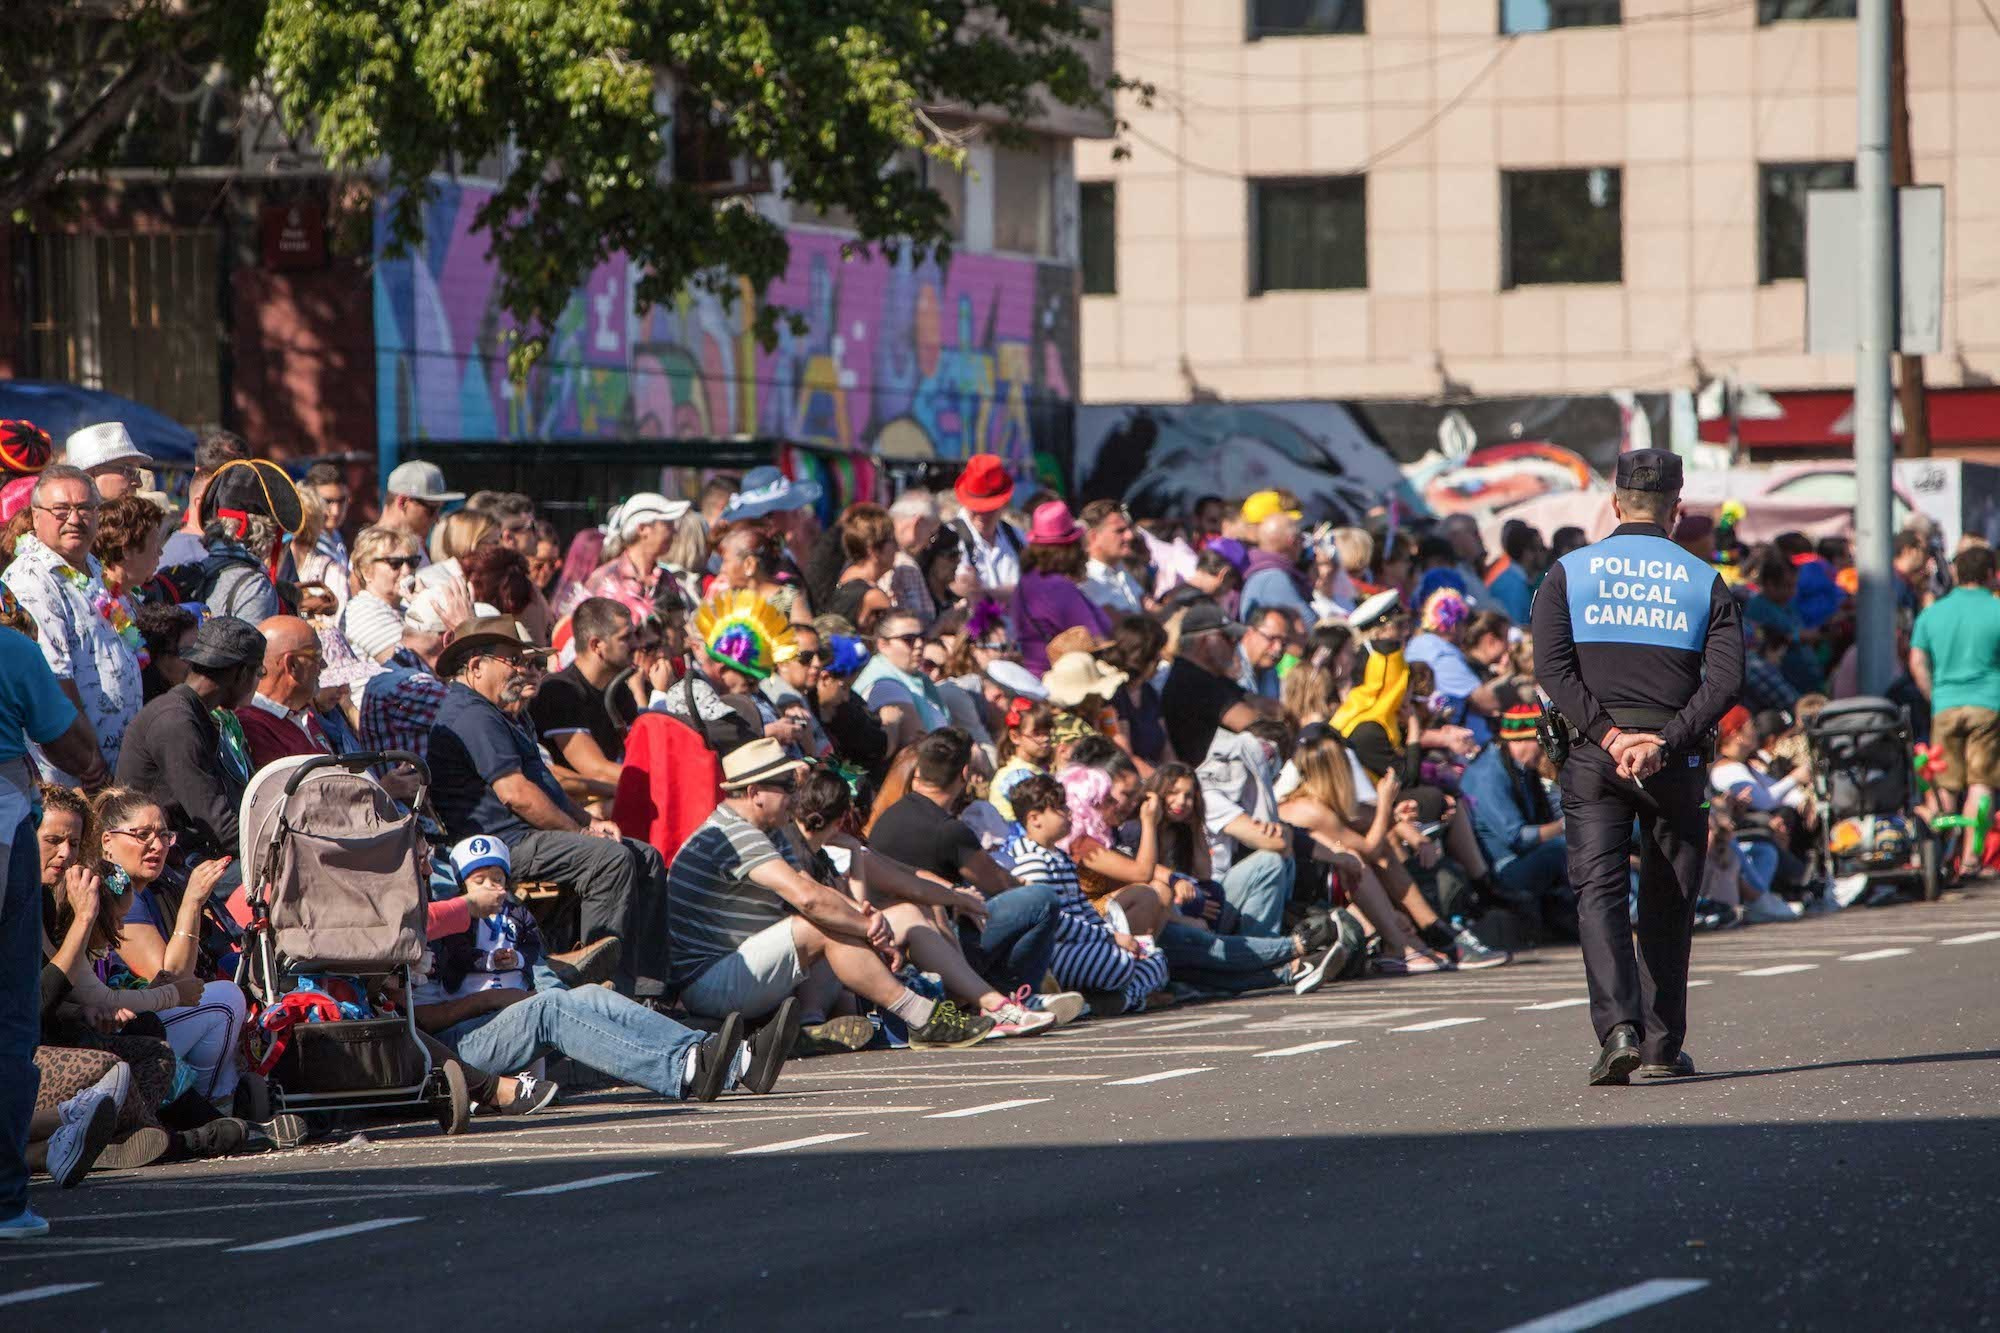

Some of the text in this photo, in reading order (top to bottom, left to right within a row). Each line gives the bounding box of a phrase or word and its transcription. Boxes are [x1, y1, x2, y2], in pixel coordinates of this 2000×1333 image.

[1590, 557, 1689, 582] POLICIA
[1599, 580, 1677, 604] LOCAL
[1585, 604, 1689, 632] CANARIA
